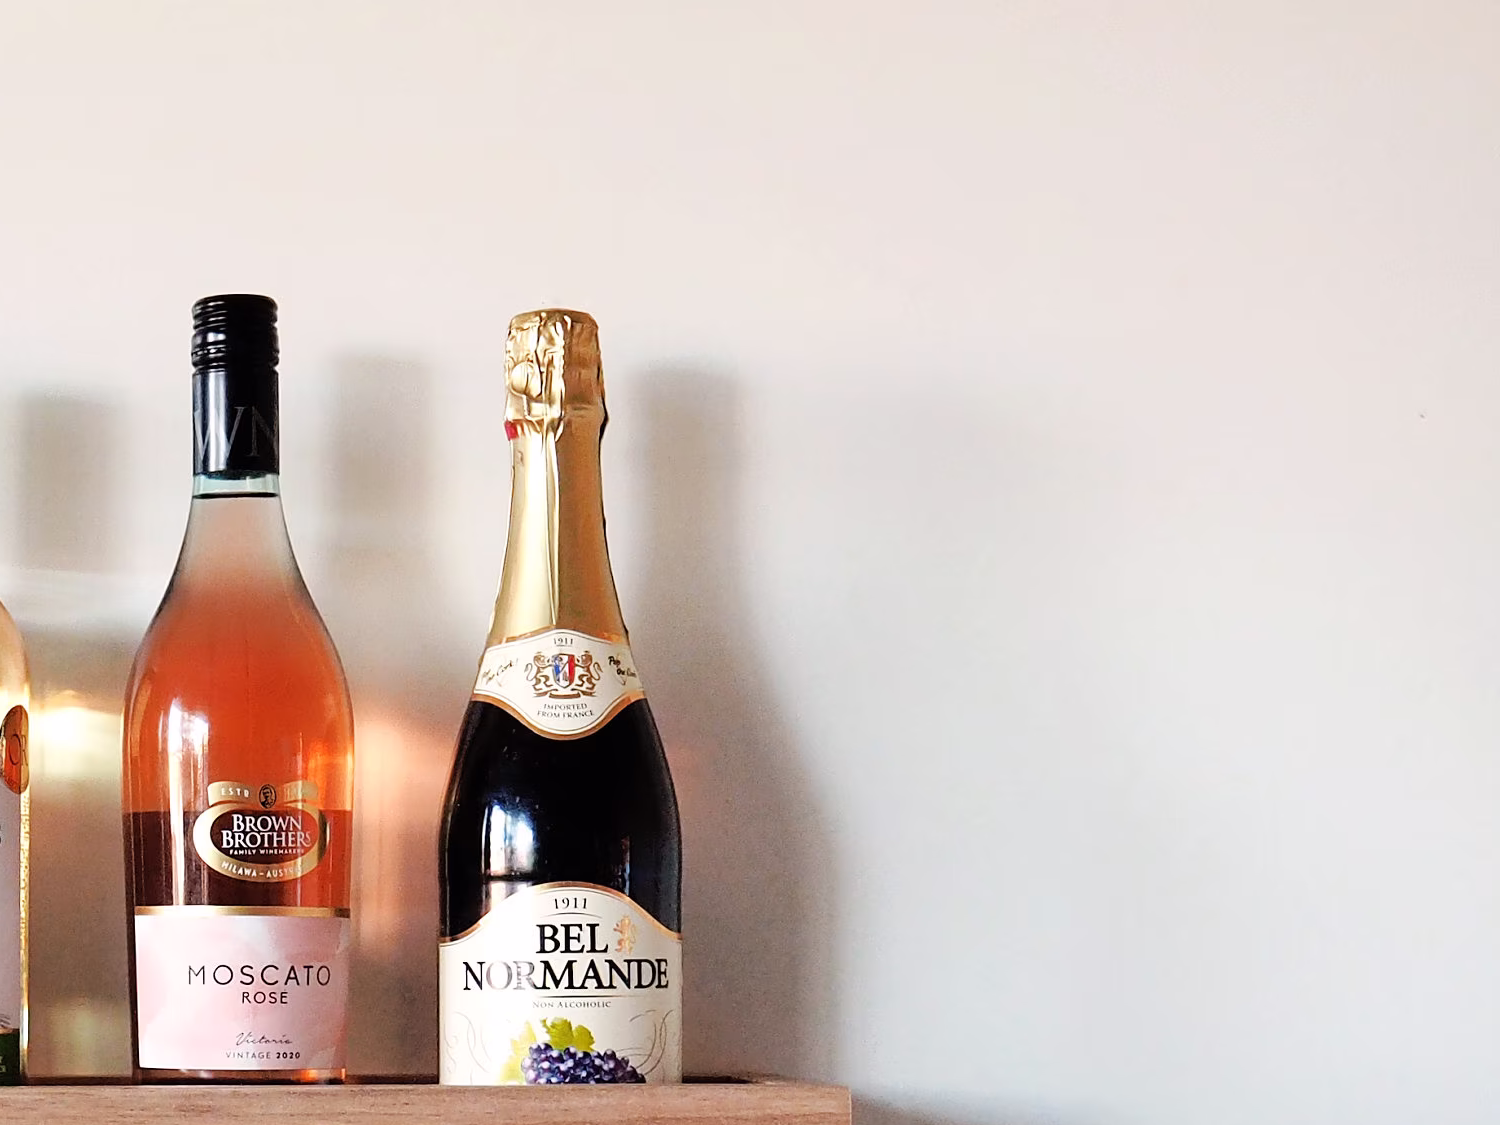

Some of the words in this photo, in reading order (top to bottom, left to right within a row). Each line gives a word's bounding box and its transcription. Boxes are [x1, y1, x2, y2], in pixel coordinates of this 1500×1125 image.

[537, 710, 560, 718] FROM
[562, 709, 594, 718] FRANCE
[232, 814, 302, 832] BROWN
[221, 830, 312, 848] BROTHERS
[221, 861, 257, 877] MILAWA
[554, 898, 588, 909] 1911
[536, 923, 609, 954] BEL
[188, 964, 331, 986] MOSCATO
[463, 958, 669, 991] NORMANDE
[225, 1052, 271, 1060] VINTAGE
